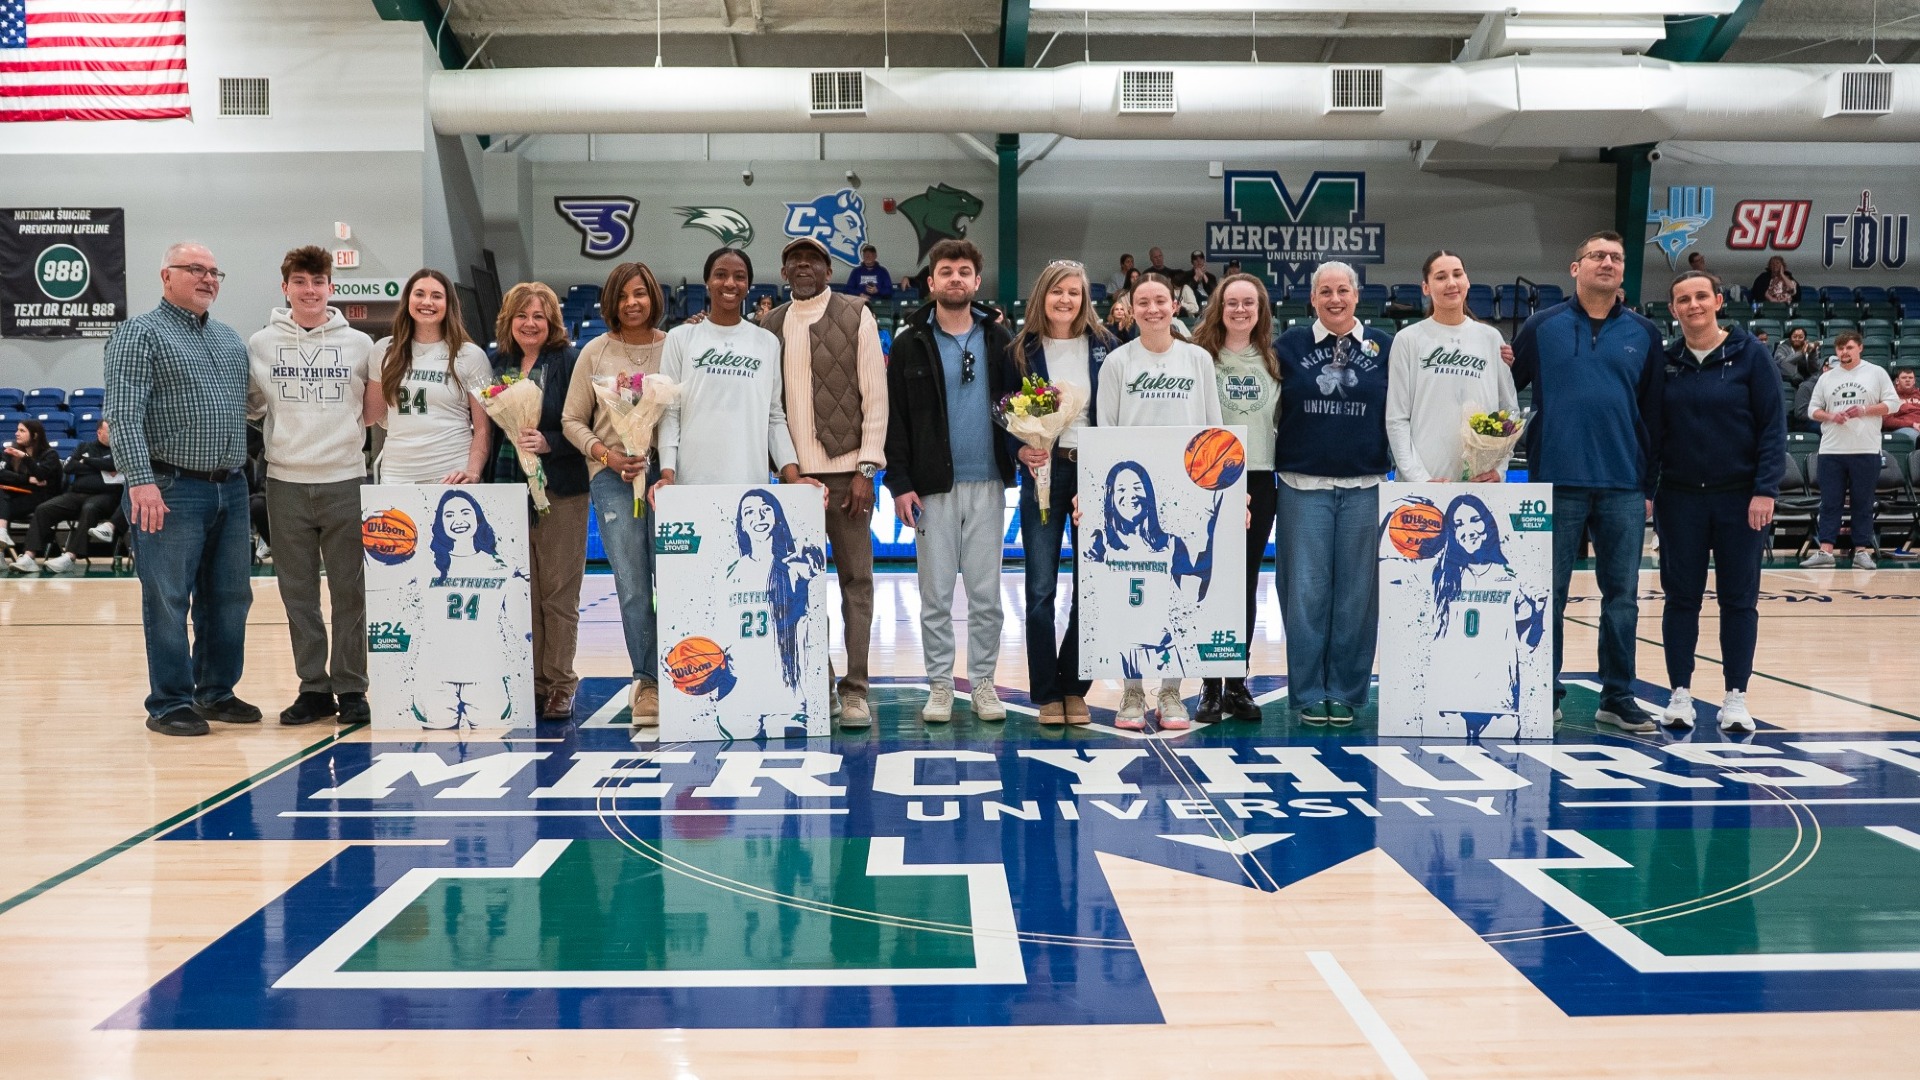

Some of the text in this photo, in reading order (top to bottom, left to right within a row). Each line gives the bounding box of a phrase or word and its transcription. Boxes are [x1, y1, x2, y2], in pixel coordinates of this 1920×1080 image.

[14, 209, 91, 220] NATIONAL SUICIDE
[19, 225, 110, 234] PREVENTION LIFELINE
[1729, 201, 1811, 248] SFU
[1210, 225, 1381, 251] MERCYHURST
[1822, 213, 1910, 270] FDU
[337, 251, 354, 265] EXIT
[1266, 251, 1324, 260] UNIVERSITY
[43, 260, 84, 281] 988
[14, 303, 116, 316] TEXT OR CALL 988
[348, 306, 365, 318] EXIT
[16, 319, 71, 327] FOR ASSISTANCE
[691, 348, 762, 371] Lakers
[1300, 346, 1380, 373] MERCURST
[1421, 346, 1489, 372] Lakers
[272, 366, 349, 378] MERCYHURST
[706, 367, 754, 378] BASKETBALL
[1434, 367, 1481, 379] BASKETBALL
[1126, 372, 1195, 394] Lakers
[398, 386, 428, 415] 24
[1140, 391, 1189, 400] BASKETBALL
[1304, 399, 1367, 416] UNIVERSITY
[1519, 499, 1547, 515] #0
[368, 522, 406, 536] Wilson
[658, 521, 695, 537] #23
[1401, 514, 1441, 529] Wilson
[1129, 577, 1145, 607] 5
[446, 592, 481, 621] 24
[368, 621, 406, 636] #24
[740, 609, 769, 639] 23
[1463, 607, 1480, 638] 0
[1210, 630, 1237, 645] #5
[671, 661, 712, 678] Wilson
[906, 796, 1500, 822] UNIVERSITY
